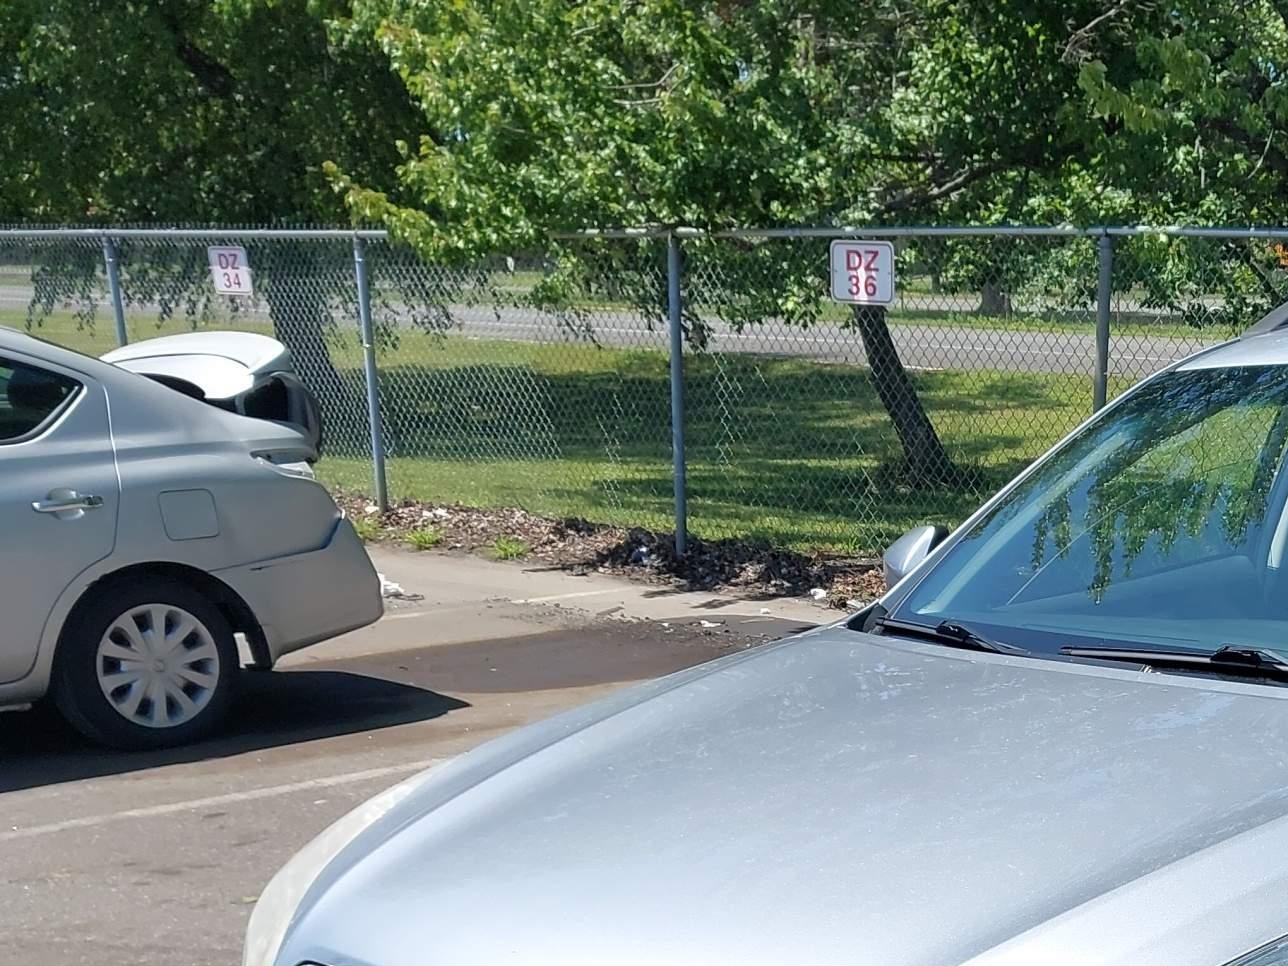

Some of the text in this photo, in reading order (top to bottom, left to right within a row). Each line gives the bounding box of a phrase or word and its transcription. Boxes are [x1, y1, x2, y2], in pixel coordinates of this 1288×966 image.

[217, 253, 241, 270] DZ
[847, 249, 880, 272] DZ
[223, 272, 242, 288] 34
[848, 274, 877, 297] 36
